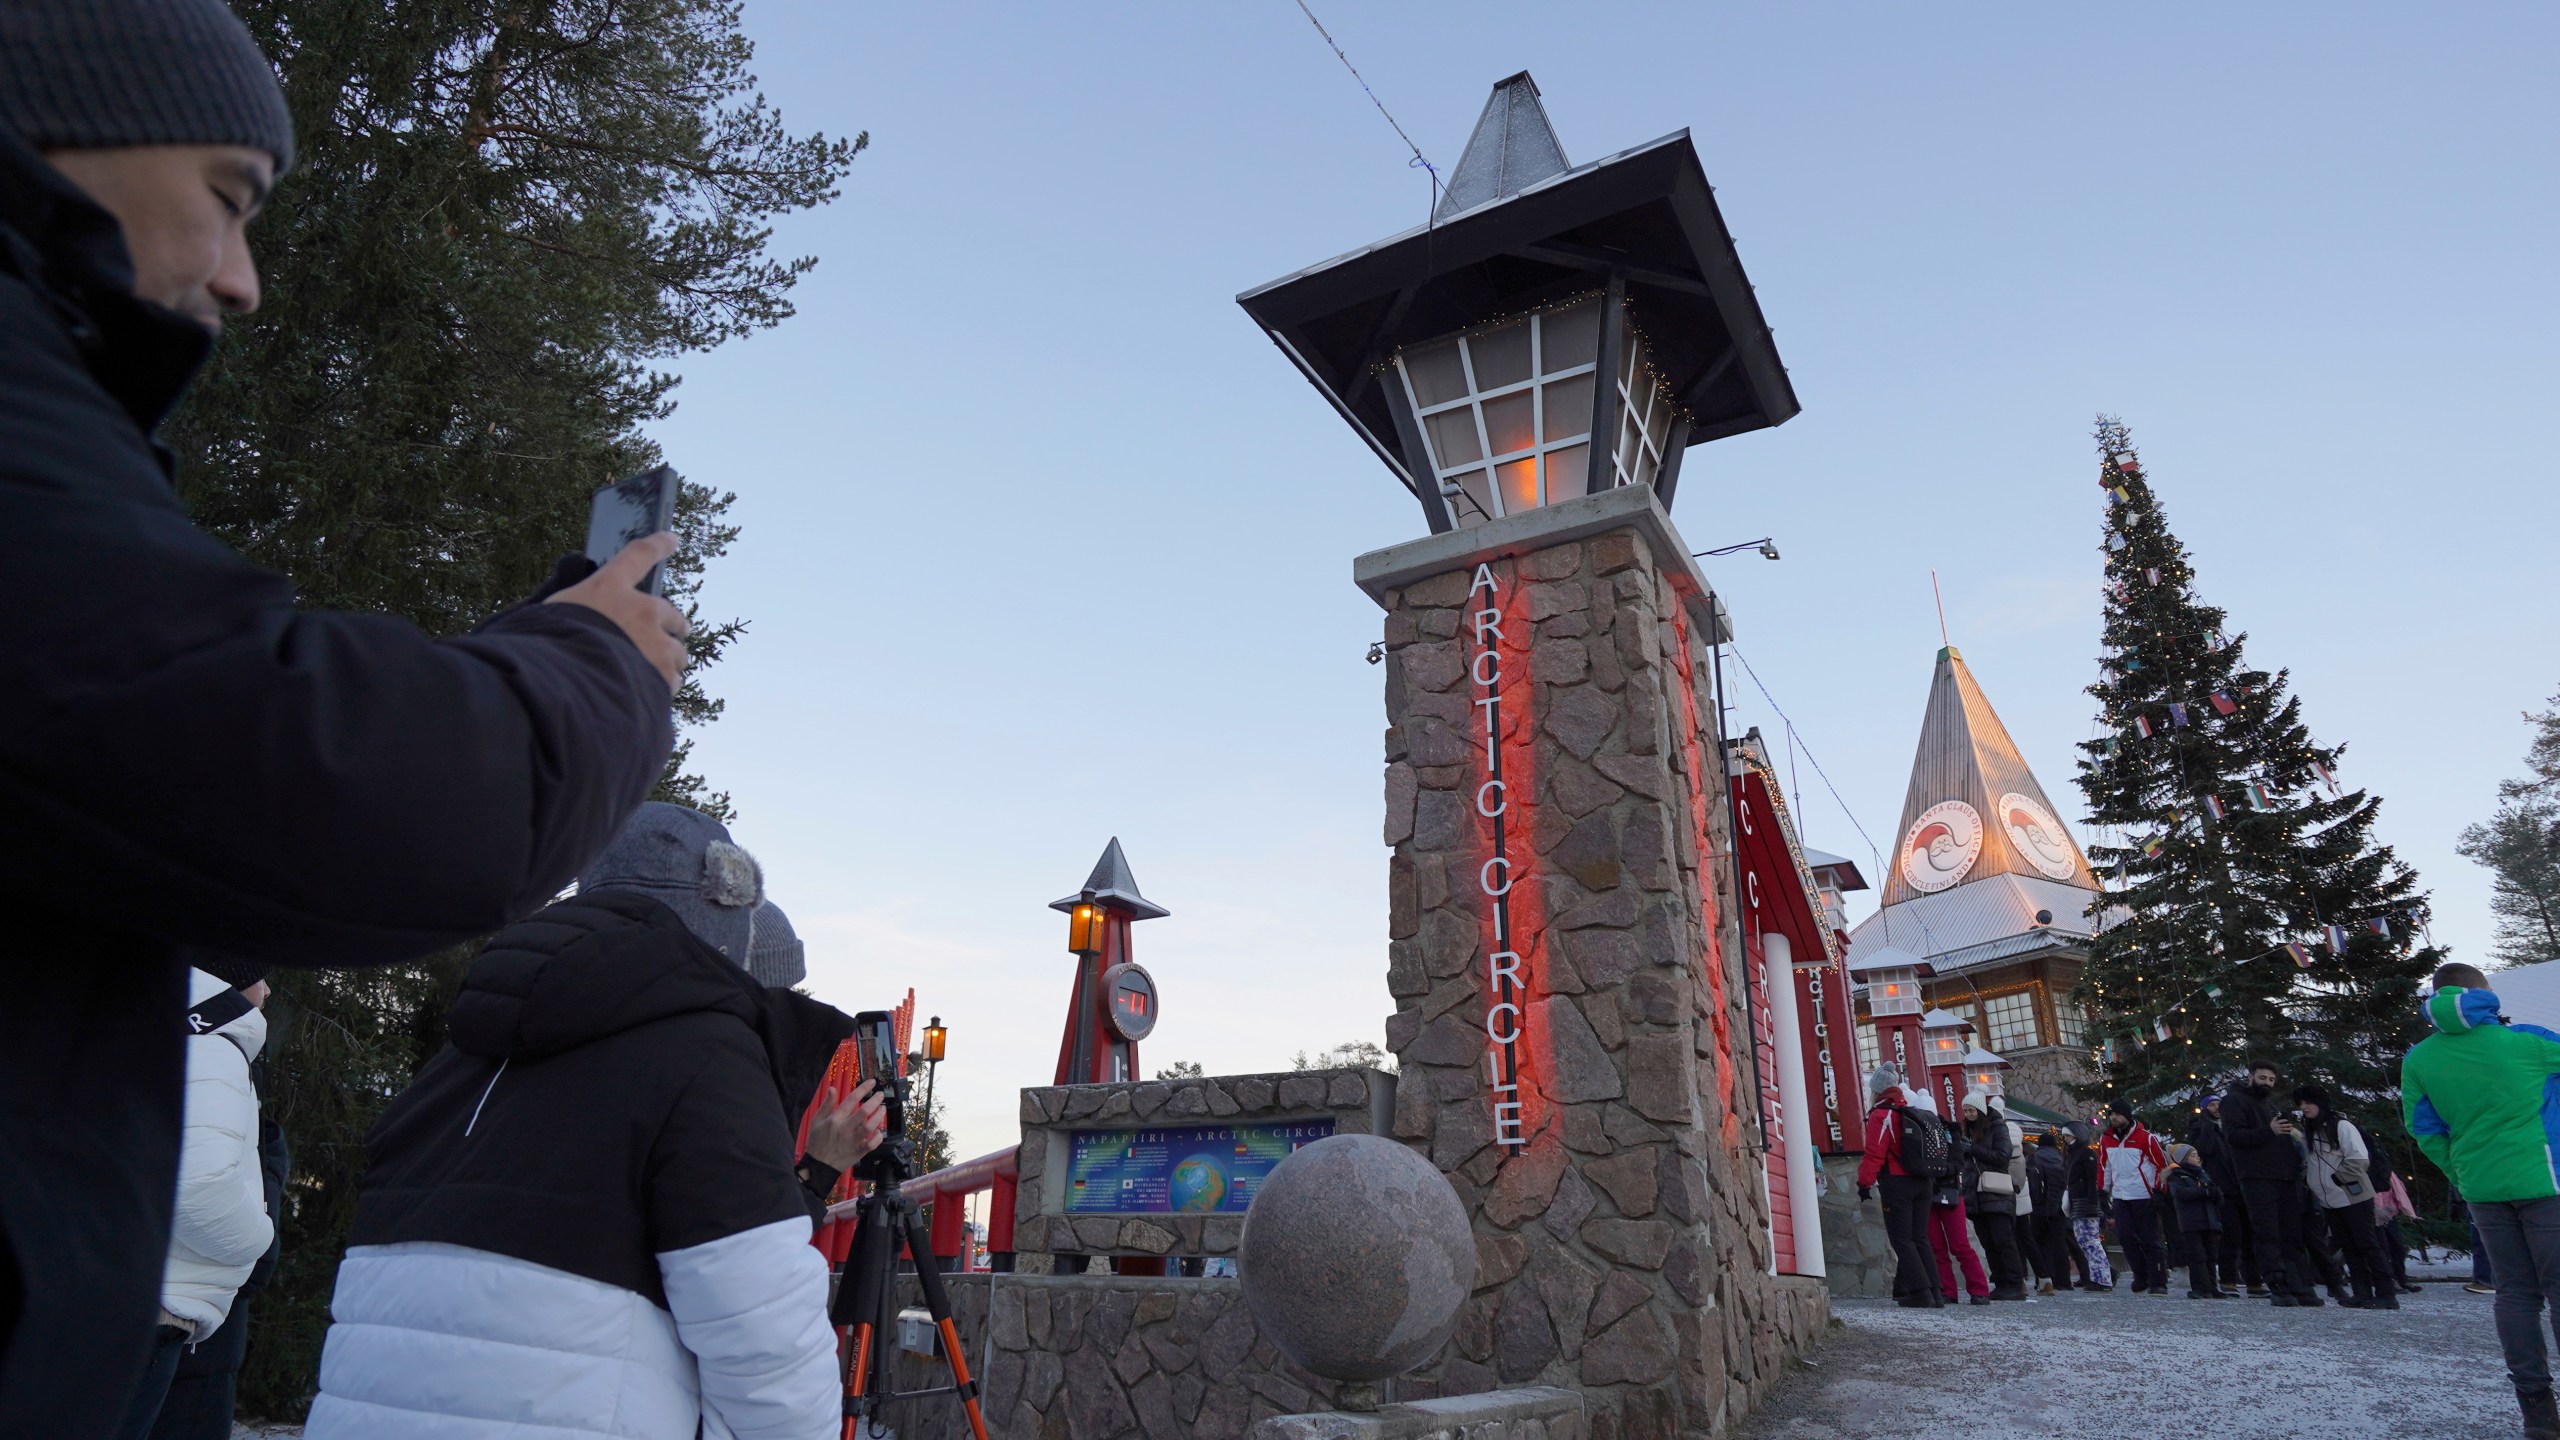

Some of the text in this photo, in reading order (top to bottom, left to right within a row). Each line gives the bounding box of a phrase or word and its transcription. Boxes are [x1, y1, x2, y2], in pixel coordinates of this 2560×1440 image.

[1469, 563, 1525, 1145] ARCTIC CIRCLE
[1916, 802, 1981, 855] SANTA CLAUS OFFICE
[1903, 836, 1969, 890] ARCTIC CIRCLE FINLAND
[1748, 871, 1784, 1142] CIRCLE
[1809, 967, 1842, 1141] RCTIC CIRCLE
[1893, 1031, 1906, 1083] ARCTI
[1944, 1077, 1957, 1122] ARCTI
[1078, 1133, 1165, 1145] NAPAPIIRI
[1195, 1130, 1260, 1141] ARCTIC
